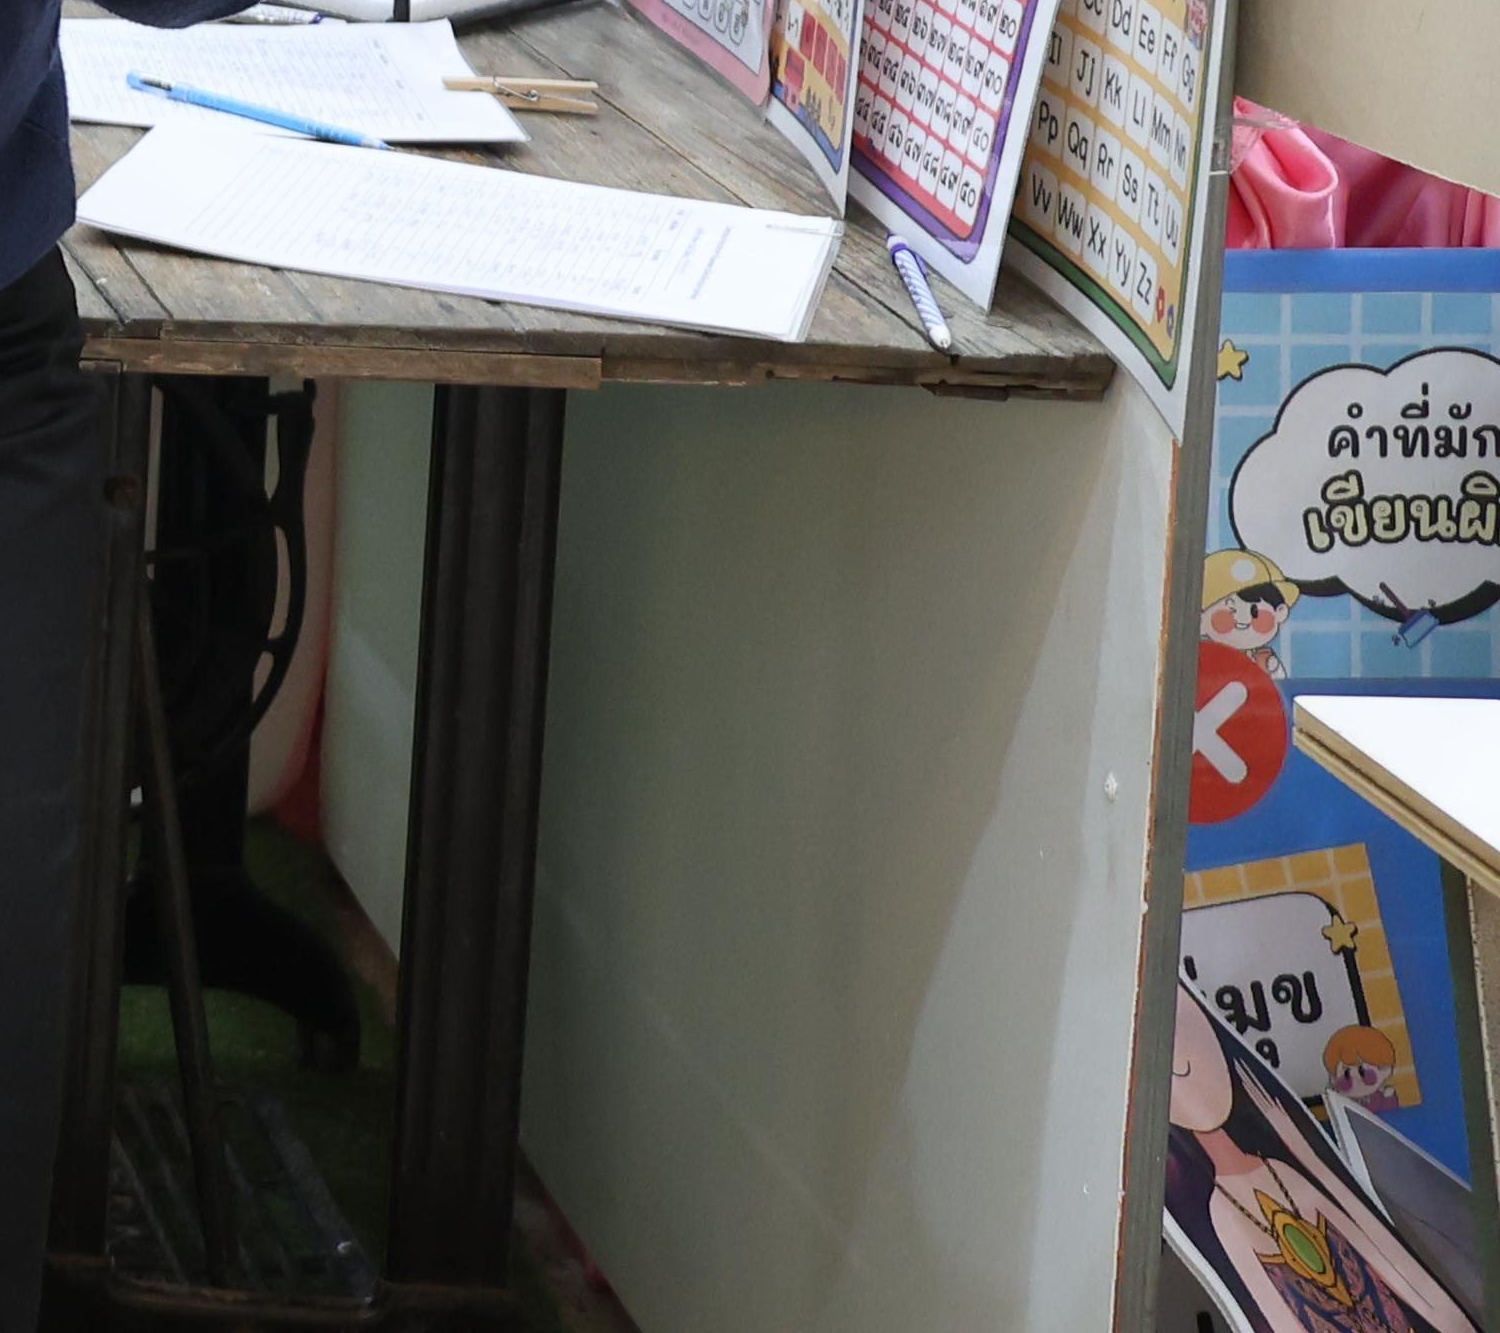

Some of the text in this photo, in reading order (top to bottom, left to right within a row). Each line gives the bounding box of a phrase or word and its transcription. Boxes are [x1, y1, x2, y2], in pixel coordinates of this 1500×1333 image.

[1076, 49, 1096, 97] Jj
[1103, 66, 1122, 110] Kk
[1133, 89, 1147, 128] Ll
[1151, 107, 1172, 159] Mm
[1174, 126, 1187, 171] Nn
[1138, 14, 1156, 55] Ee
[1163, 34, 1178, 73] Ff
[1181, 52, 1196, 103] Gg
[1037, 100, 1179, 249] Pp Qq Rr Ss Tt Uu
[1031, 172, 1153, 306] Vv Ww Xx Yy Zz
[1303, 469, 1500, 554] เขียนผิ
